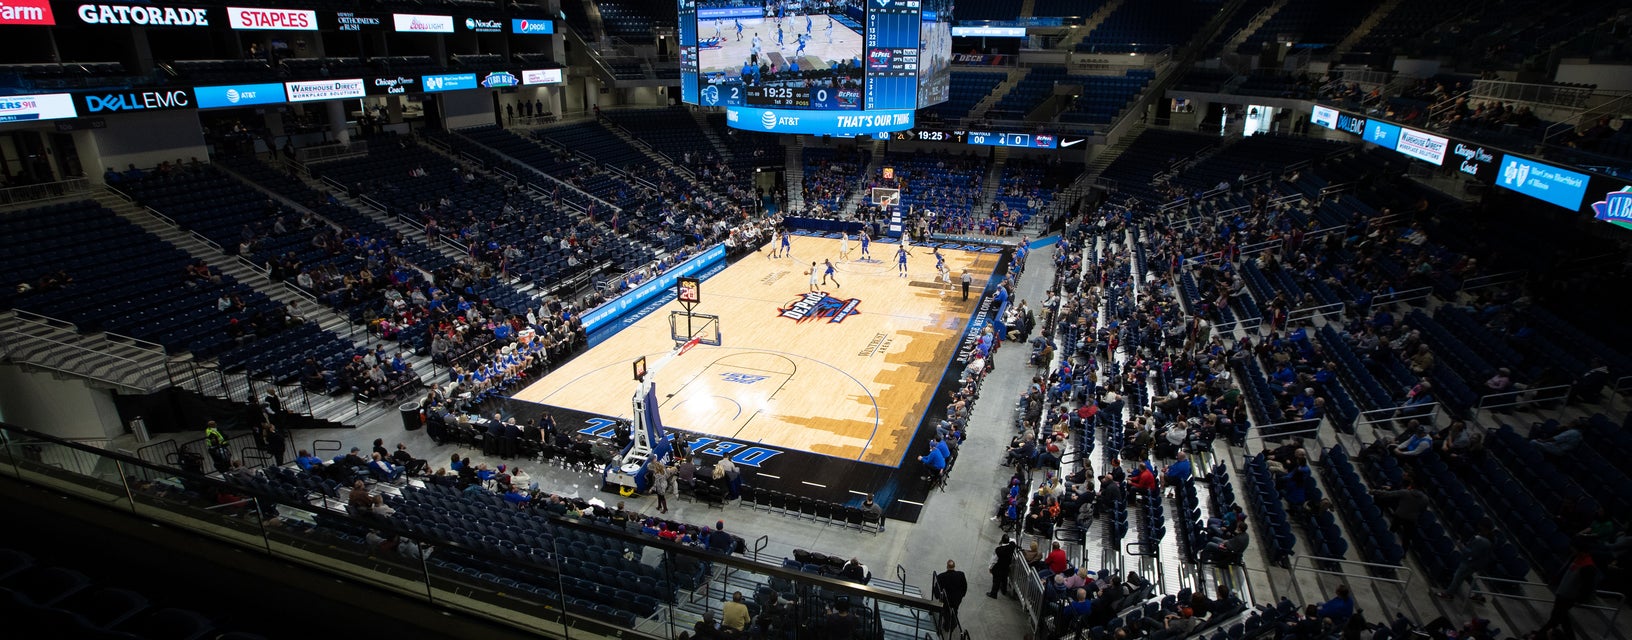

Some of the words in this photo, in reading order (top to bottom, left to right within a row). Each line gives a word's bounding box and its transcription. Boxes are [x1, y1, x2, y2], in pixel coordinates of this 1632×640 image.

[78, 4, 209, 26] GATORADE
[240, 11, 308, 28] STAPLES
[475, 19, 502, 29] NovaCare
[529, 22, 545, 31] pepsi
[291, 84, 333, 93] WAREHOUSE
[335, 82, 358, 90] DIRECT
[375, 78, 397, 87] Chicago
[240, 91, 257, 99] AT&T
[387, 85, 405, 94] Coach
[730, 87, 739, 99] 2
[763, 87, 793, 98] 19:25
[817, 89, 828, 102] 0
[778, 117, 800, 126] AT&T
[836, 115, 873, 128] THAT'S
[873, 114, 892, 127] OUR
[892, 112, 911, 125] THING
[878, 131, 889, 139] 00
[918, 130, 943, 140] 19:25
[974, 136, 985, 144] 00
[1015, 135, 1022, 145] 0
[998, 137, 1005, 145] 4
[1401, 132, 1427, 148] WAREHOUSE
[1425, 138, 1442, 151] DIRECT
[1460, 160, 1479, 175] Coach
[680, 287, 696, 300] 20
[782, 291, 828, 321] DEPAUL
[956, 349, 970, 363] RAY
[972, 311, 988, 327] MEYER
[980, 296, 993, 311] COURT
